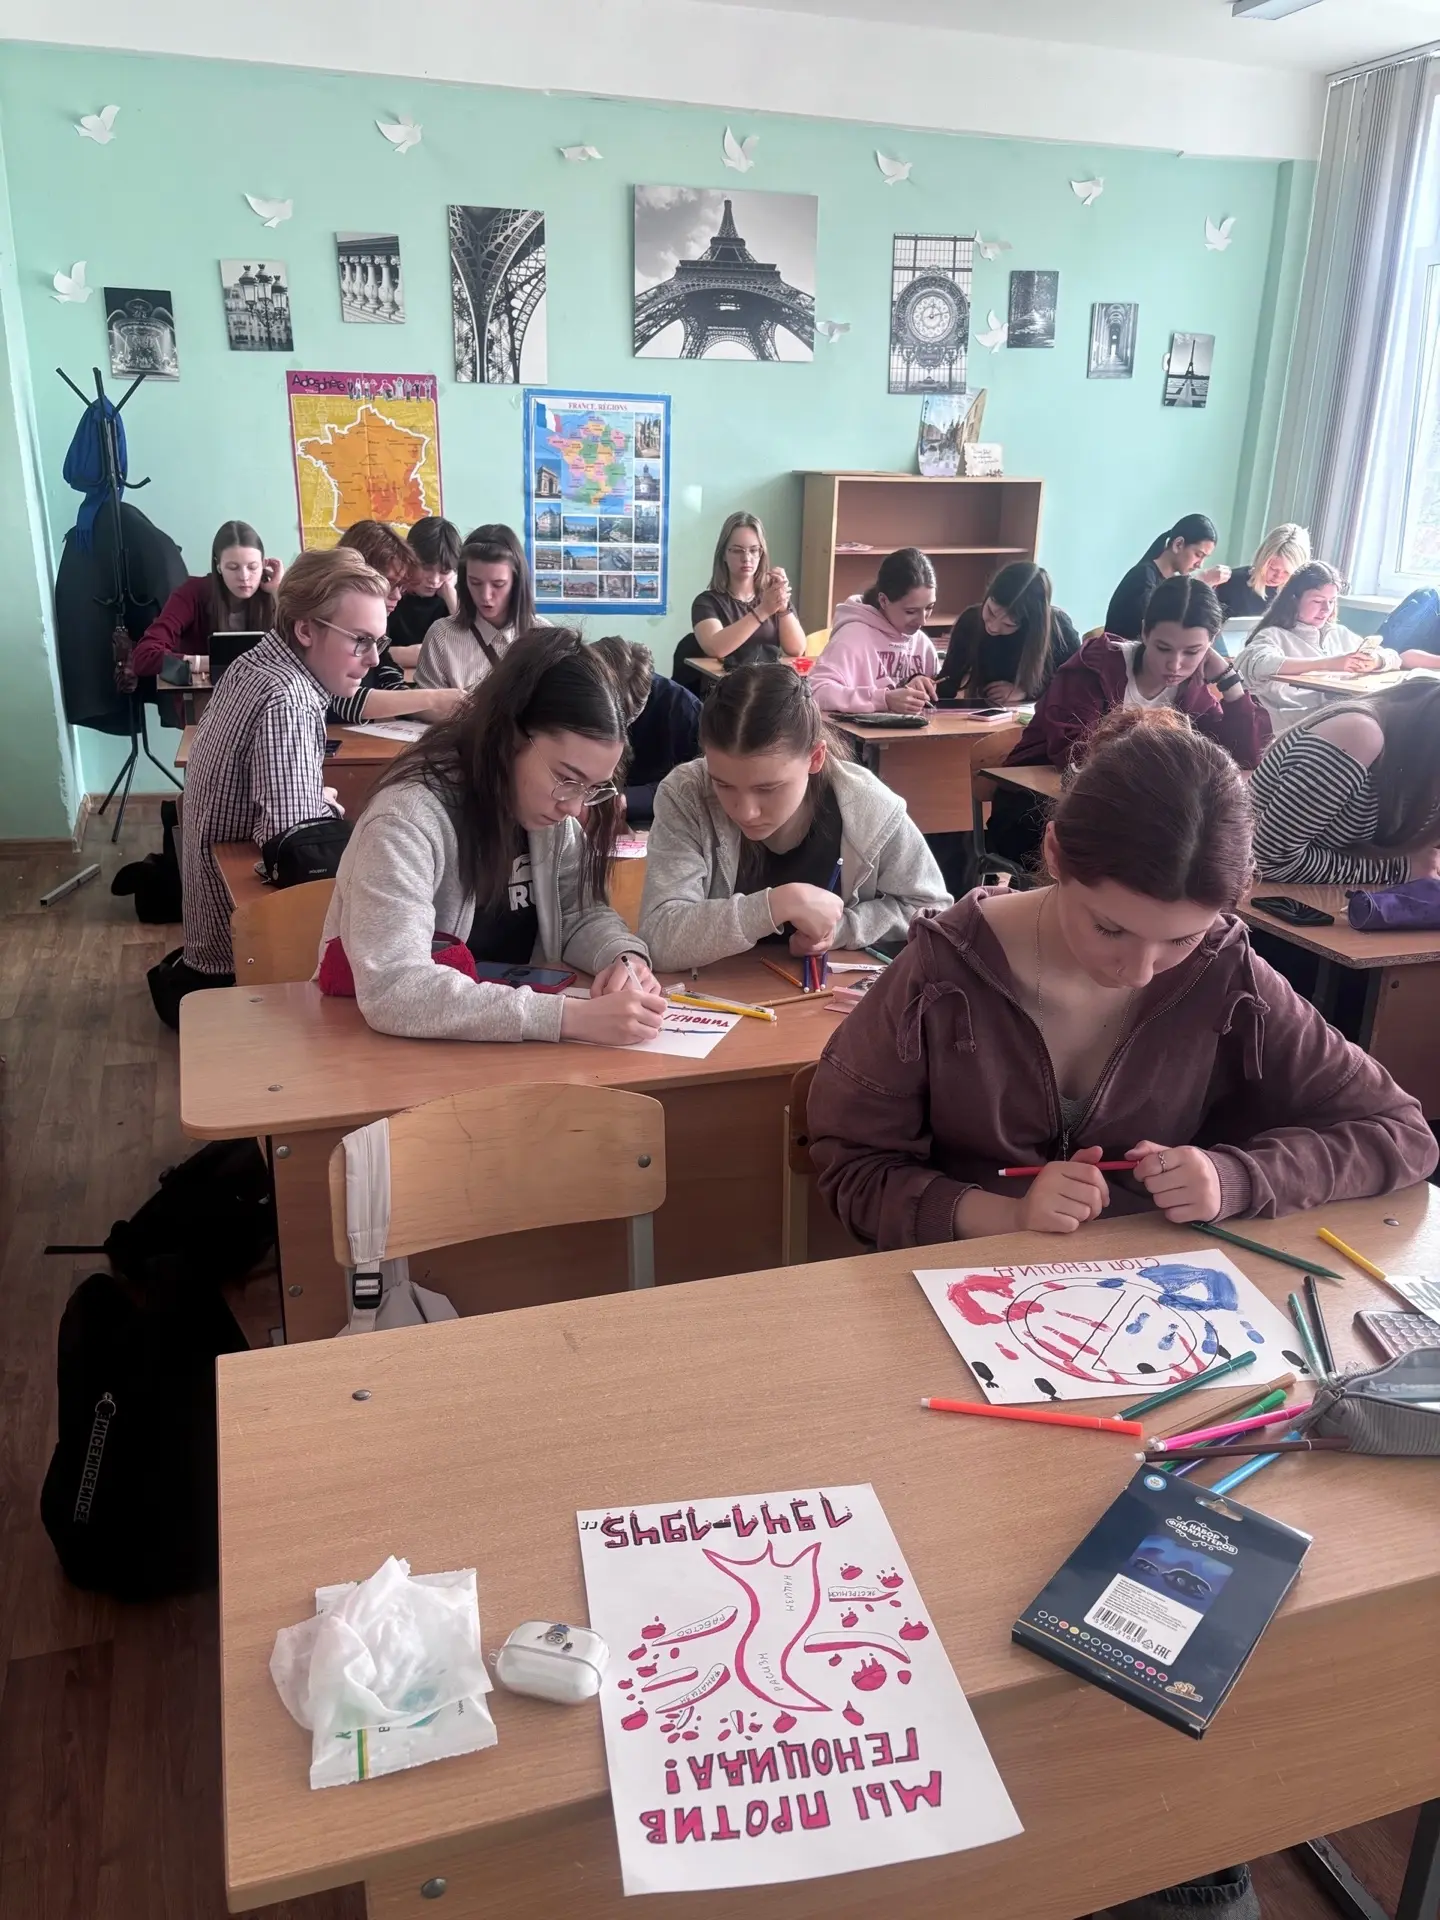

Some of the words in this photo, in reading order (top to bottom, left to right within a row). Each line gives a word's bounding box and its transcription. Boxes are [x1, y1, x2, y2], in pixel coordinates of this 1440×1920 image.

[292, 374, 346, 392] Adosphère
[994, 1262, 1101, 1278] ГЕНОЦИД
[1108, 1257, 1160, 1271] СТОП
[1168, 1520, 1235, 1553] ФЛОМАСТЕРОВ
[1189, 1523, 1221, 1540] НАБОР
[783, 1574, 795, 1612] НАЦИЗМ
[676, 1612, 726, 1638] РАБСТВО
[678, 1669, 722, 1705] ФАНАТИЗМ
[757, 1652, 785, 1692] РАСИЗМ
[664, 1727, 920, 1795] ГЕНОЦИДА!
[852, 1770, 942, 1821] МЫ
[639, 1789, 831, 1844] ПРОТИВ
